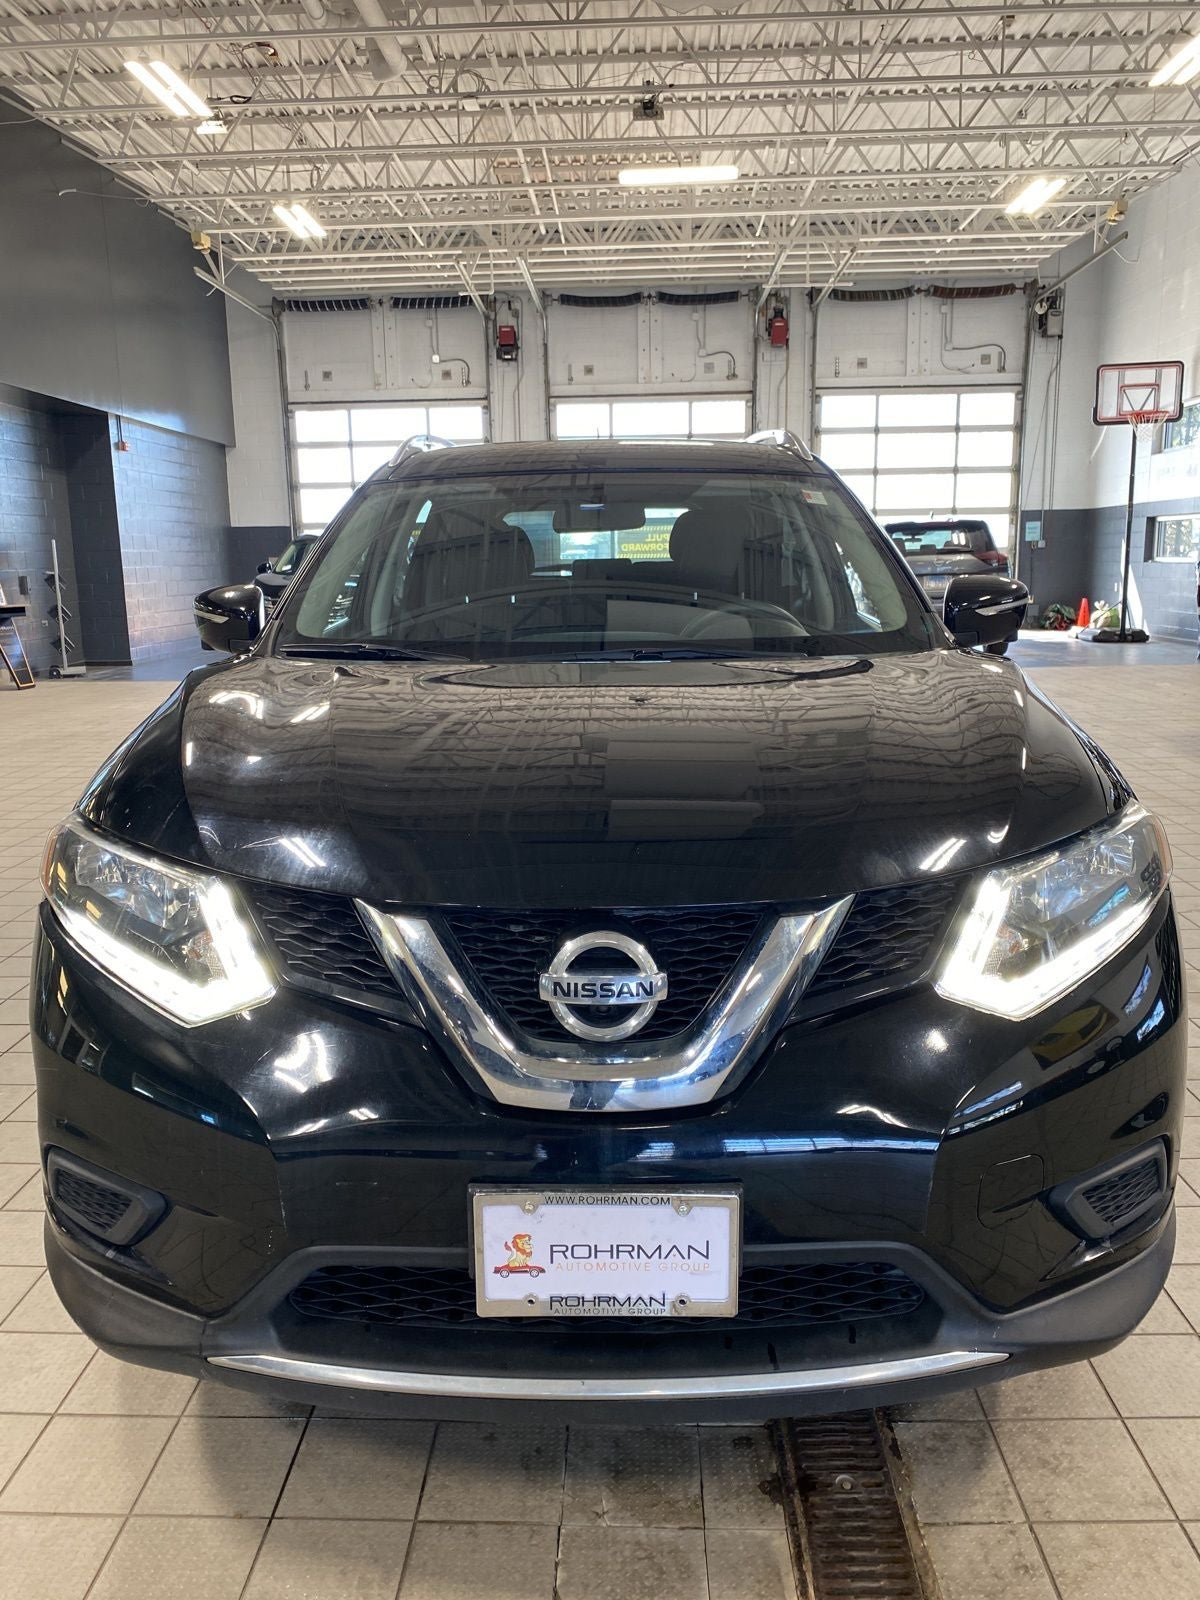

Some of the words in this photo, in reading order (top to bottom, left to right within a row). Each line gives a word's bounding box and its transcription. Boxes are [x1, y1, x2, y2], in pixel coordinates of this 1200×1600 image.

[553, 981, 654, 998] NISSAN
[544, 1195, 671, 1206] WWW.ROHRMAN.COM
[550, 1240, 710, 1264] ROHRMAN
[556, 1262, 650, 1272] AUTOMOTIVE
[659, 1262, 710, 1272] GROUP
[549, 1292, 666, 1310] ROHRMAN
[554, 1307, 622, 1316] AUTOMOTIVE
[628, 1307, 666, 1316] GROUP
